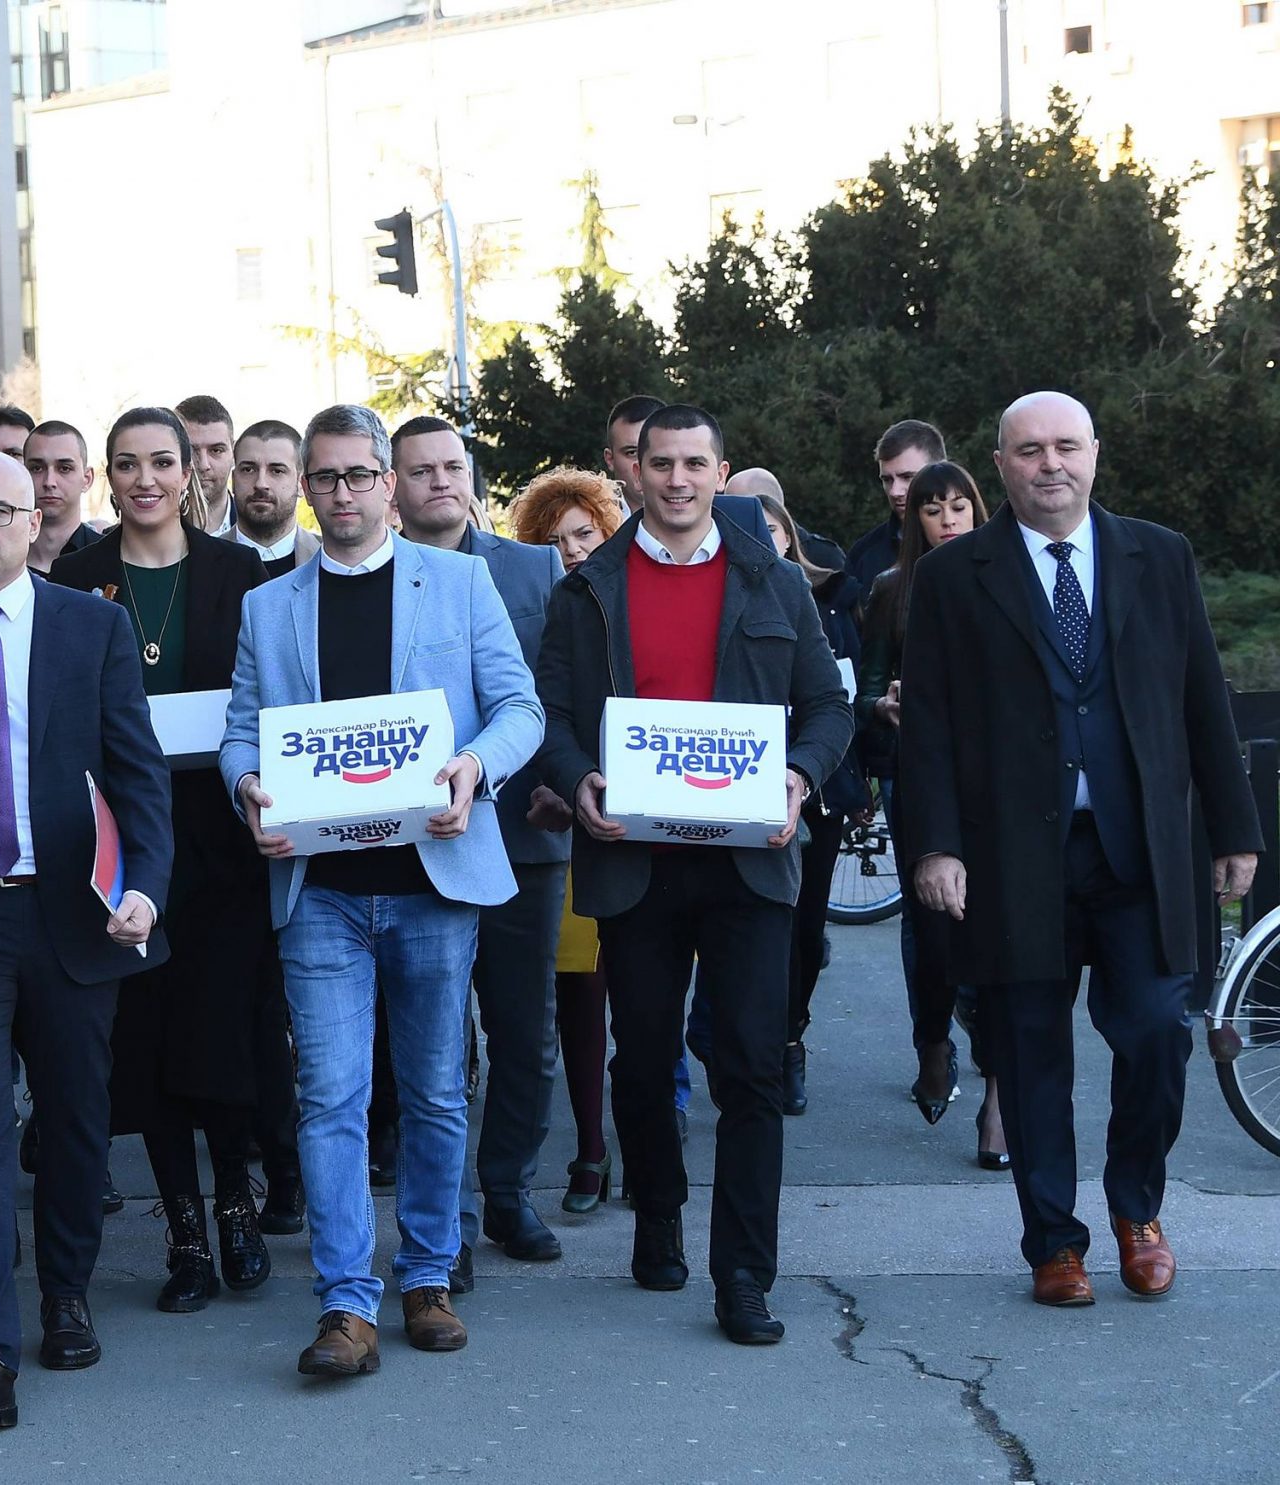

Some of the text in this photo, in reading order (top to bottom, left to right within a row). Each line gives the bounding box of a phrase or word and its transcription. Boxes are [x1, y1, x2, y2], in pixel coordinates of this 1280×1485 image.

[306, 716, 415, 736] Александар Вучић
[649, 724, 755, 738] Александар Вучић
[281, 725, 430, 757] За нашу
[625, 726, 768, 762] За нашу
[313, 744, 420, 777] децу.
[656, 753, 759, 780] децу.
[317, 820, 402, 837] За нашу
